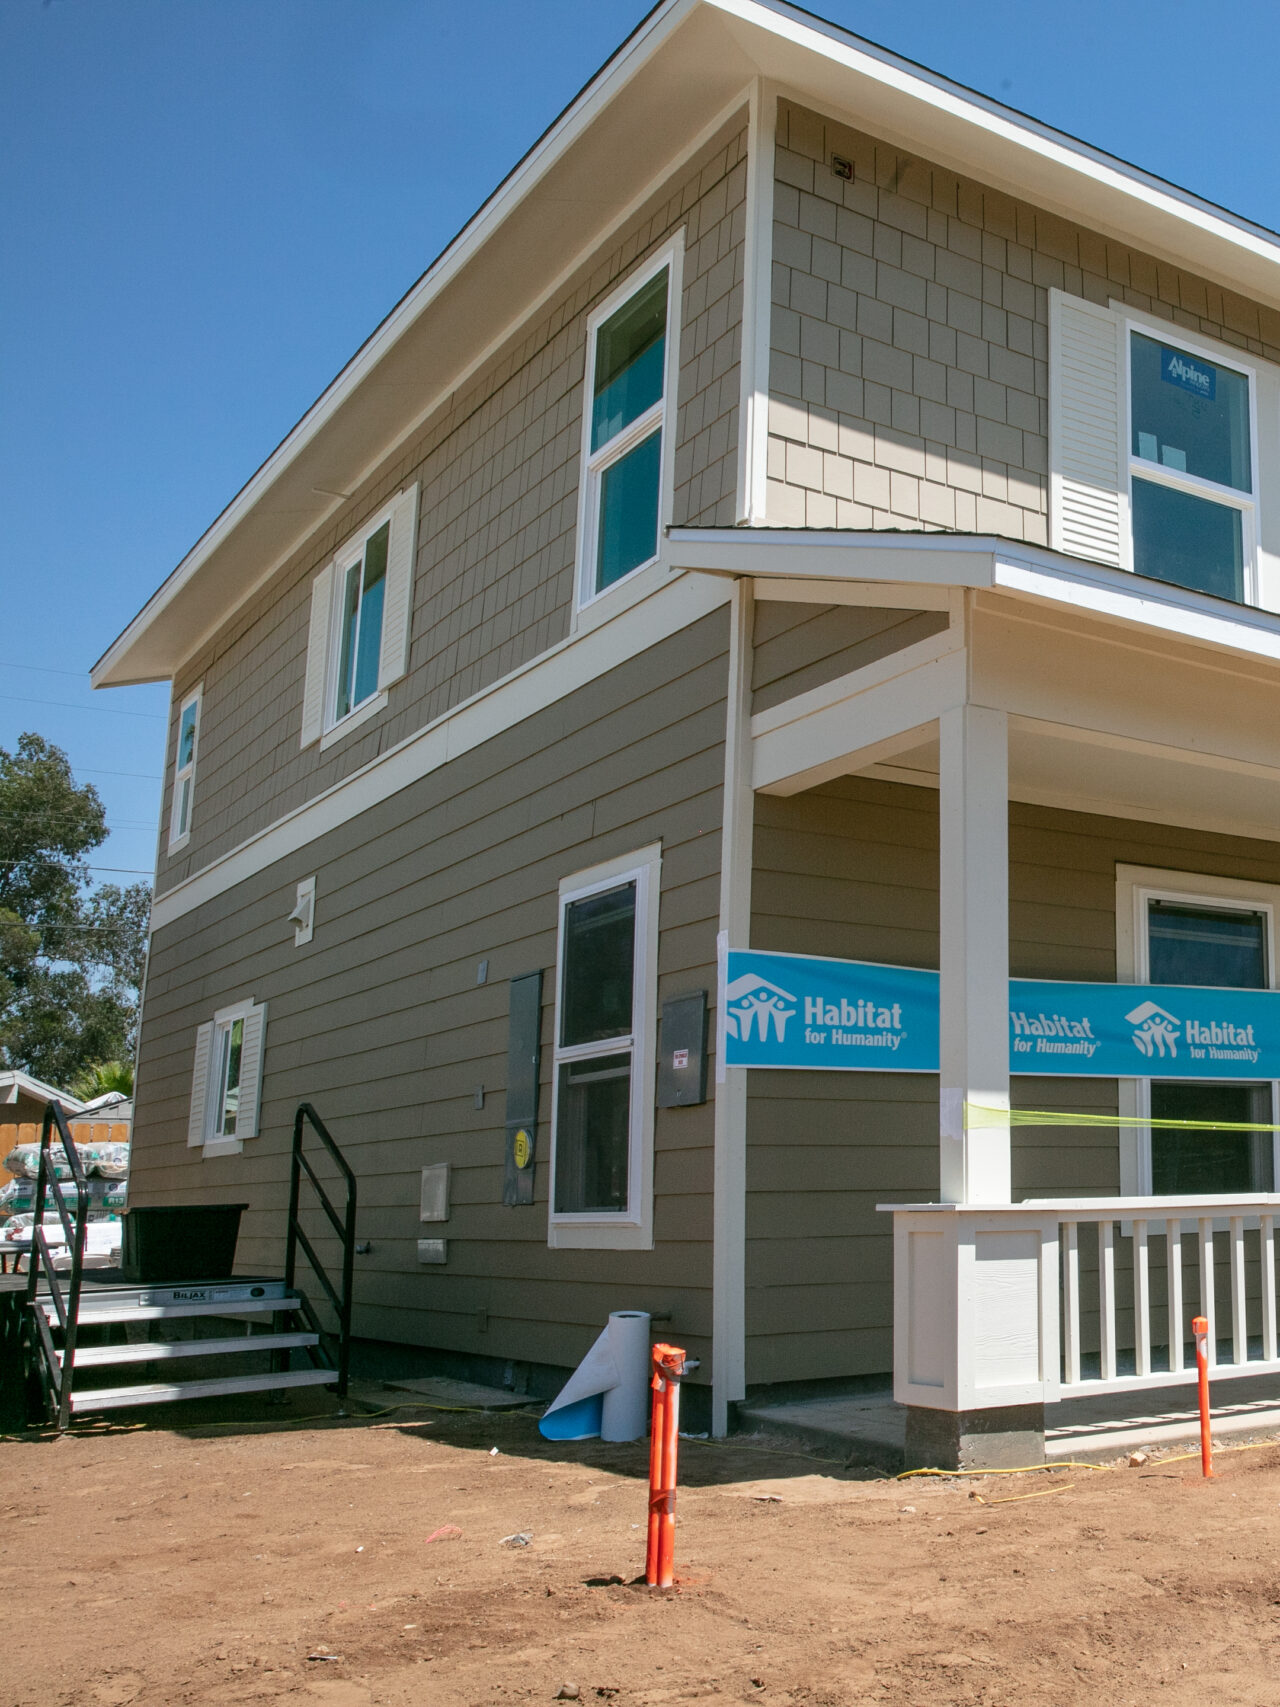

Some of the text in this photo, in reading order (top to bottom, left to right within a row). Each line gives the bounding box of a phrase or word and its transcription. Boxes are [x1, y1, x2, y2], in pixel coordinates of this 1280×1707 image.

[1168, 356, 1209, 386] Alpine
[805, 997, 901, 1029] Habitat
[1012, 1012, 1094, 1039] Habitat
[805, 1028, 901, 1051] for Humanity
[1186, 1020, 1255, 1047] Habitat
[1014, 1037, 1096, 1058] for Humanity
[1190, 1046, 1259, 1064] for Humanity
